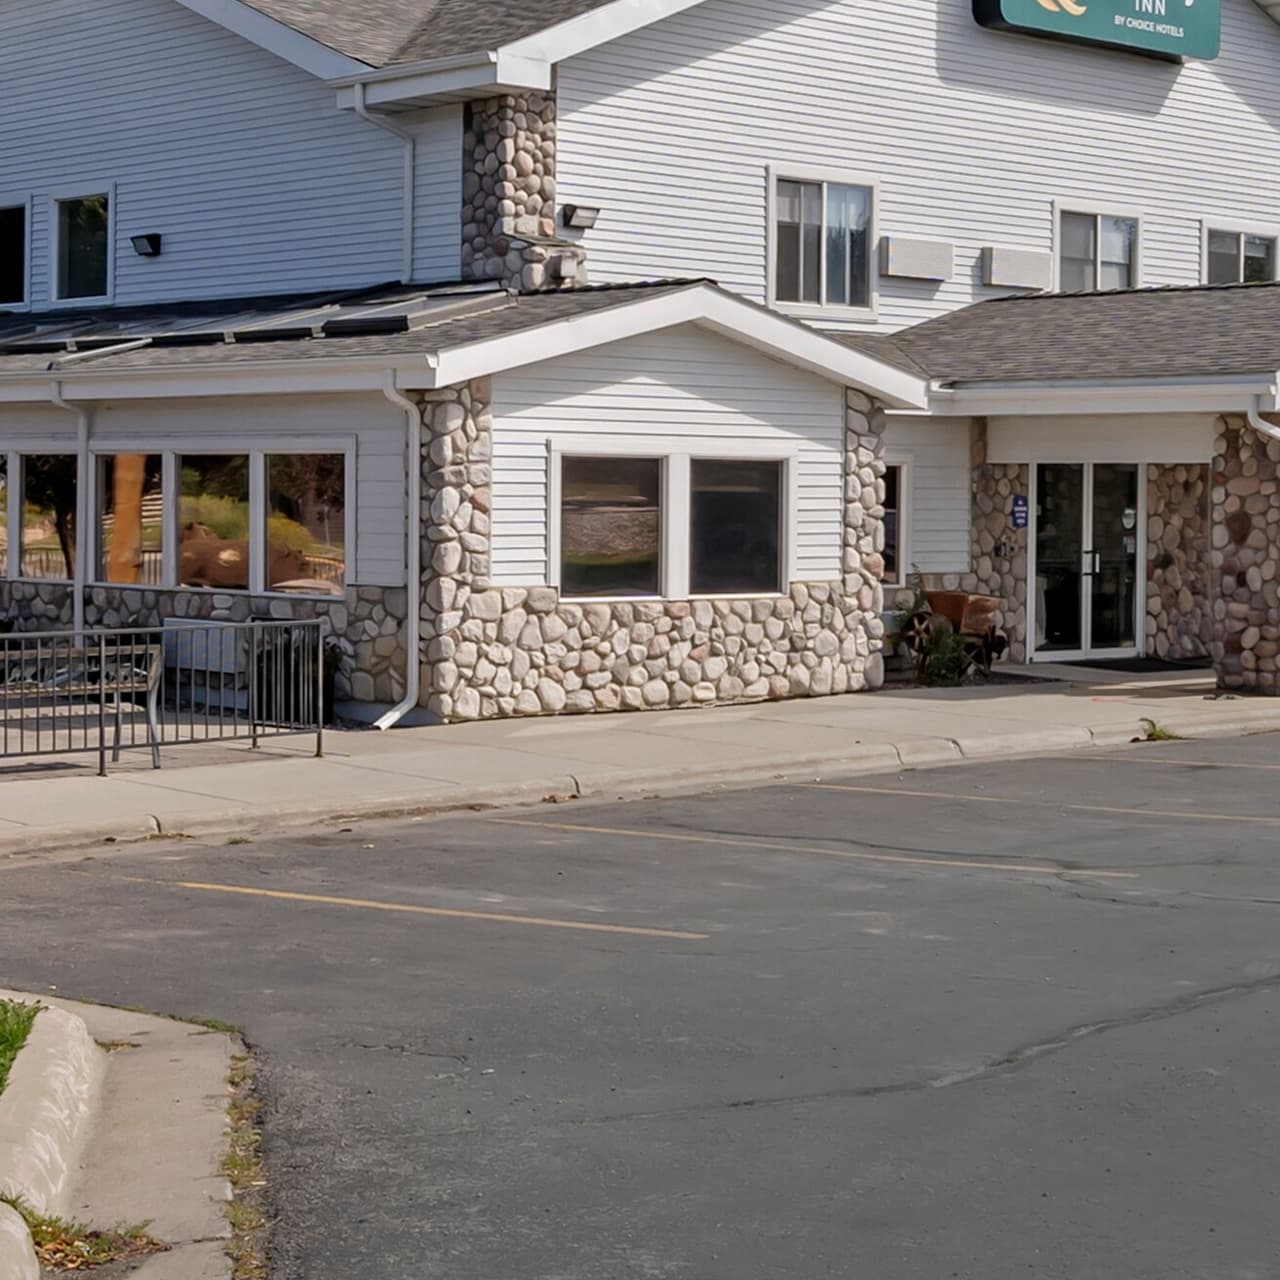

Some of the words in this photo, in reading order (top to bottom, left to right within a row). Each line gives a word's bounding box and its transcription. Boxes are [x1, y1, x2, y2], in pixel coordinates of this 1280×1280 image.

[1114, 14, 1126, 25] BY
[1125, 17, 1155, 33] CHOICE
[1155, 23, 1185, 38] HOTELS
